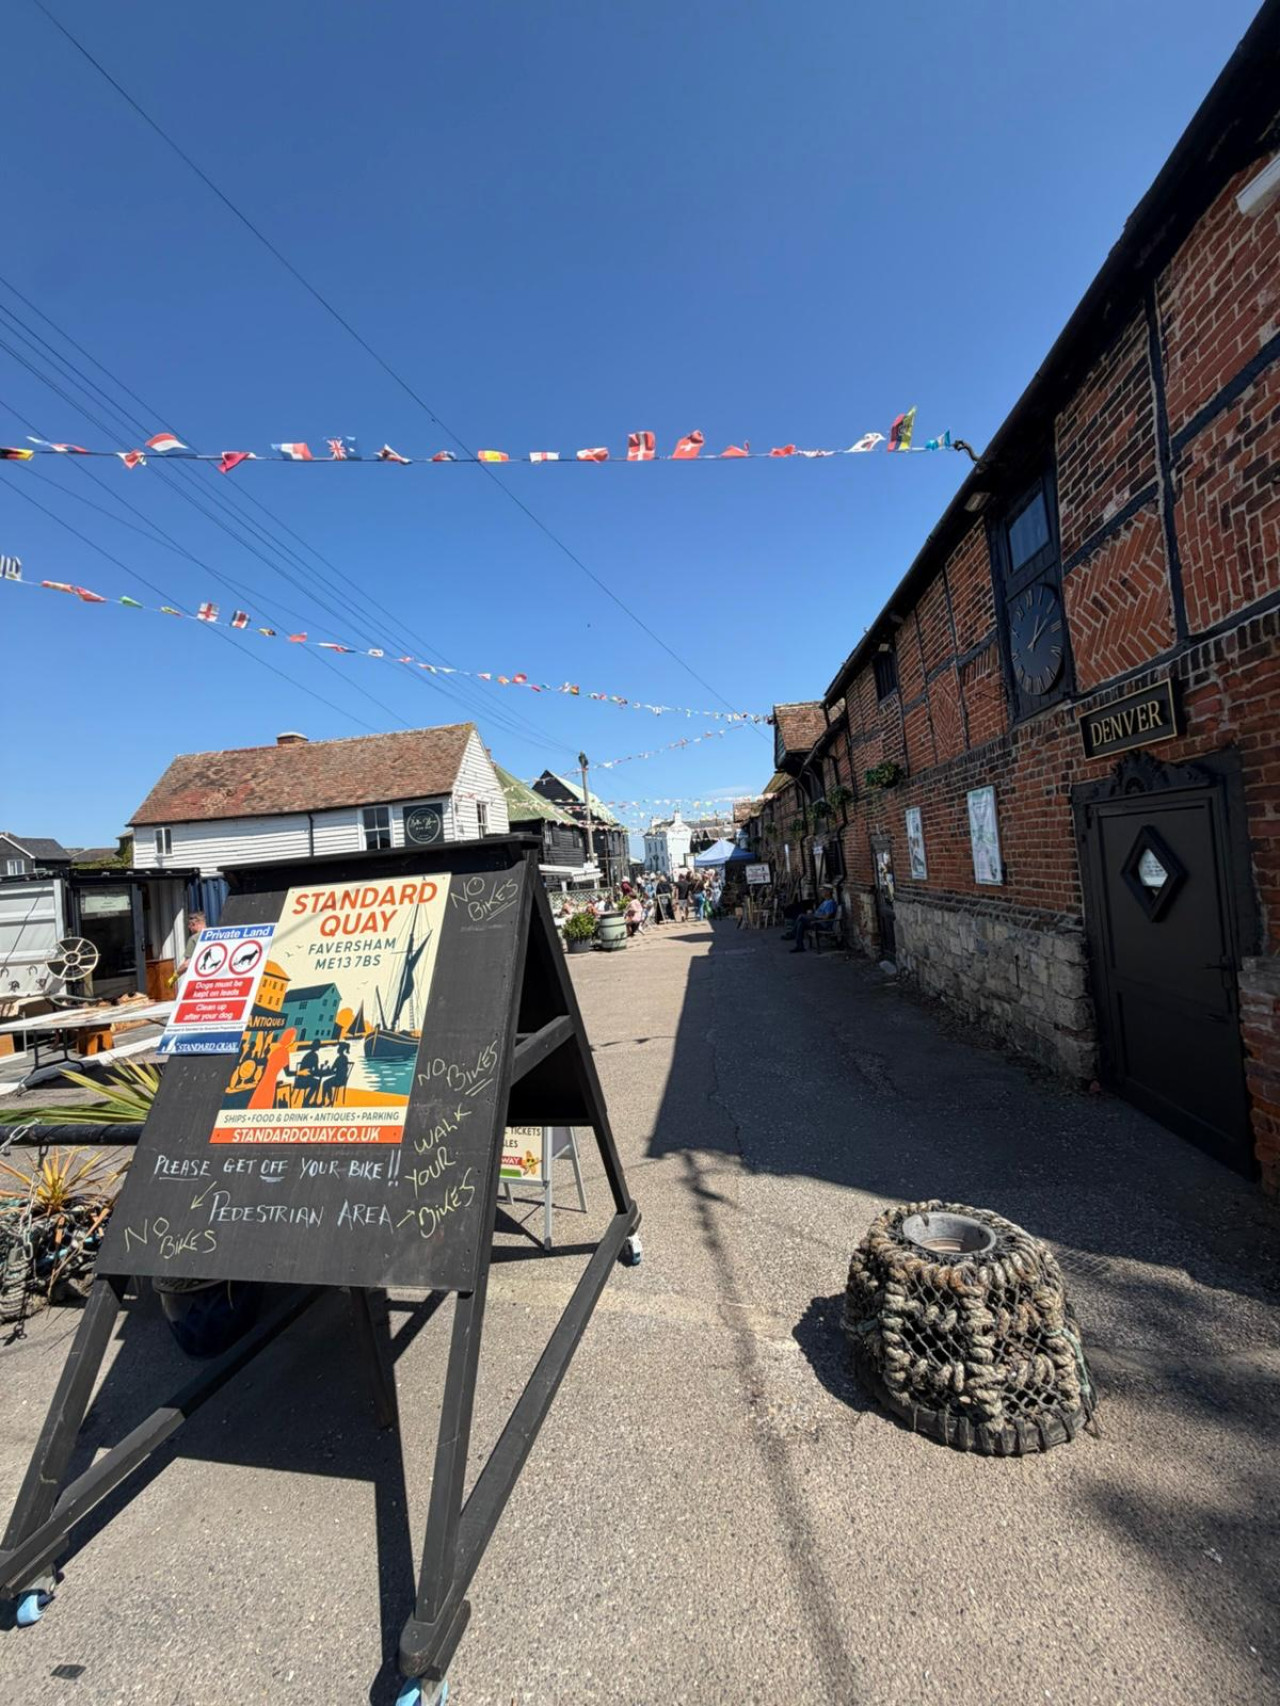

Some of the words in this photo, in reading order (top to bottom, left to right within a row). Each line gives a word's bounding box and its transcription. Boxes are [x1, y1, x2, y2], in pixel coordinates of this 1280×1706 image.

[1090, 700, 1163, 747] DENVER
[292, 881, 438, 915] STANDARD
[450, 877, 485, 908] NO
[205, 930, 240, 940] Private
[243, 926, 271, 937] Land
[320, 909, 398, 937] QUAY
[308, 937, 396, 955] FAVERSHAM
[193, 990, 209, 998] kept
[220, 988, 240, 997] leads
[195, 981, 213, 990] Dogs
[214, 980, 234, 988] must
[234, 979, 244, 987] be
[183, 1013, 200, 1021] after
[201, 1013, 219, 1022] your
[219, 1011, 234, 1021] dog
[248, 1015, 286, 1028] ANTIQUES
[418, 1058, 447, 1087] NO
[224, 1114, 247, 1123] SHIPS
[251, 1113, 275, 1123] FOOD
[283, 1112, 309, 1122] DRINK
[314, 1112, 356, 1121] ANTIQUES
[361, 1111, 399, 1121] PARKING
[414, 1103, 473, 1153] WALK
[232, 1127, 381, 1143] STANDARDQUAY.CO.UK
[511, 1127, 541, 1136] TICKETS
[154, 1155, 211, 1177] PLEASE
[223, 1158, 257, 1174] GET
[261, 1159, 289, 1174] OFF
[300, 1158, 340, 1179] YOUR
[405, 1147, 457, 1199] YOUR
[208, 1190, 324, 1226] PEDESTRIAN
[337, 1200, 394, 1234] AREA
[124, 1217, 169, 1252] NO
